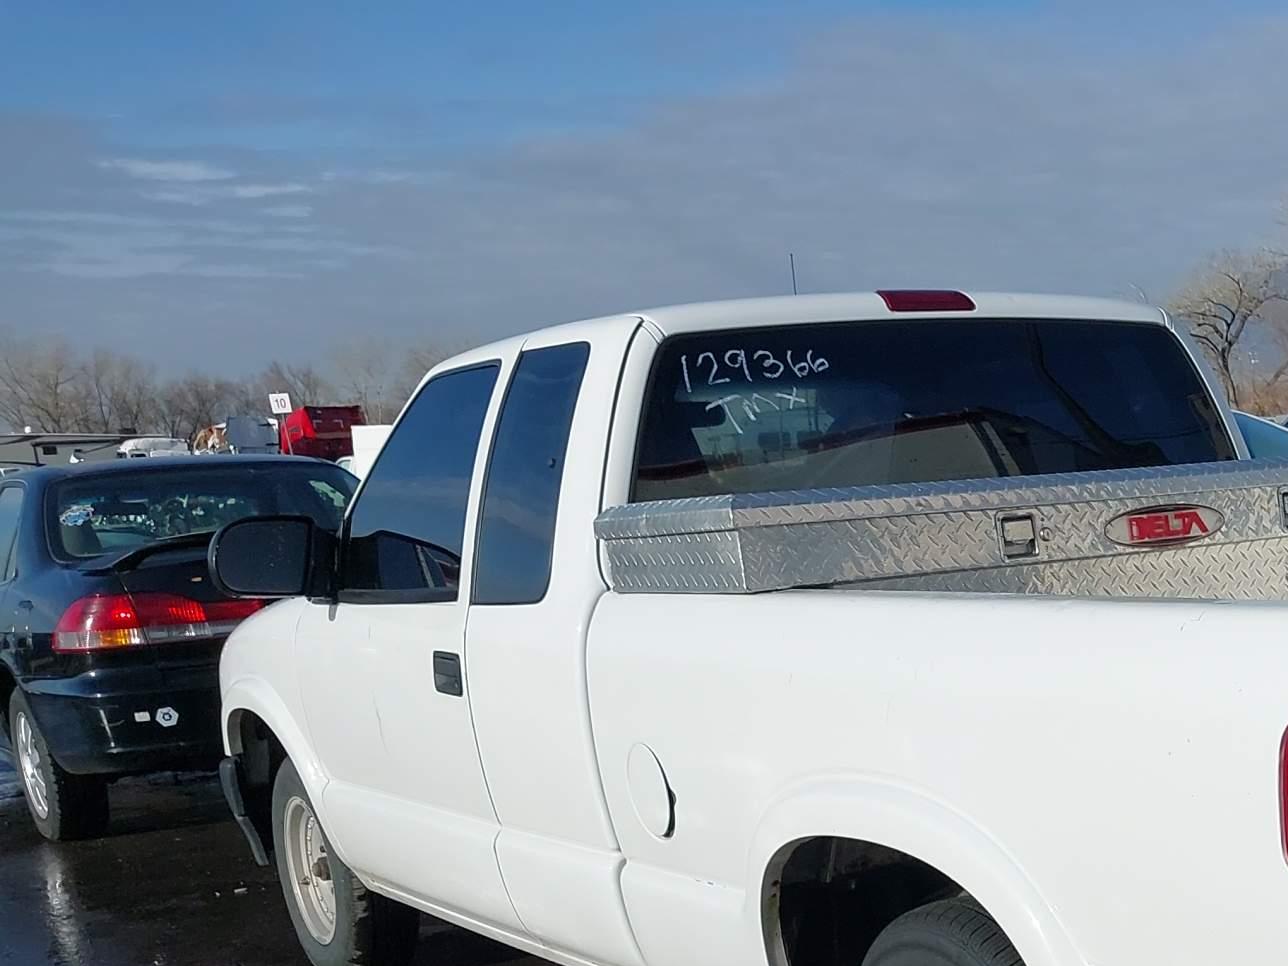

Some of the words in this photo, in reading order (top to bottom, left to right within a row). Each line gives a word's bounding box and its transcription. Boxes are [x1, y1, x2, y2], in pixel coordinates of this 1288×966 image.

[681, 349, 830, 393] 129366
[275, 398, 287, 408] 10
[705, 386, 806, 434] TMX
[1127, 510, 1209, 543] DELTA
